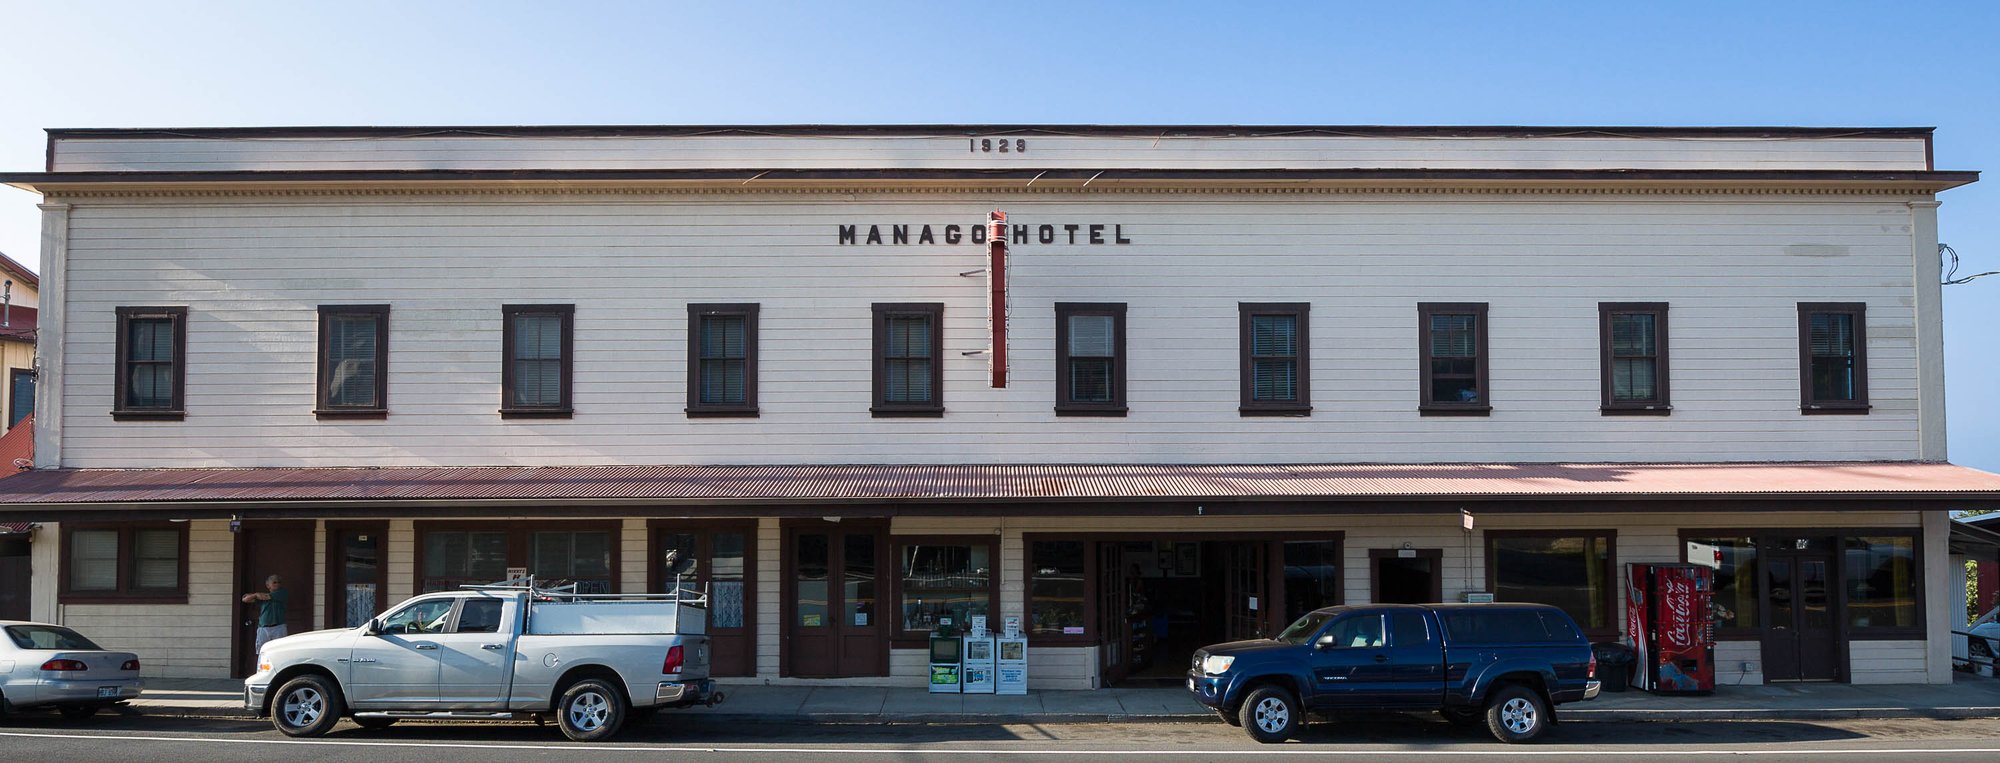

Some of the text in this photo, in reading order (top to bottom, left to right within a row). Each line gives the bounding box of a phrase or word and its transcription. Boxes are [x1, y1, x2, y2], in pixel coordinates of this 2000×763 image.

[970, 138, 1026, 153] 1929
[838, 223, 1131, 245] MANAGO HOTEL
